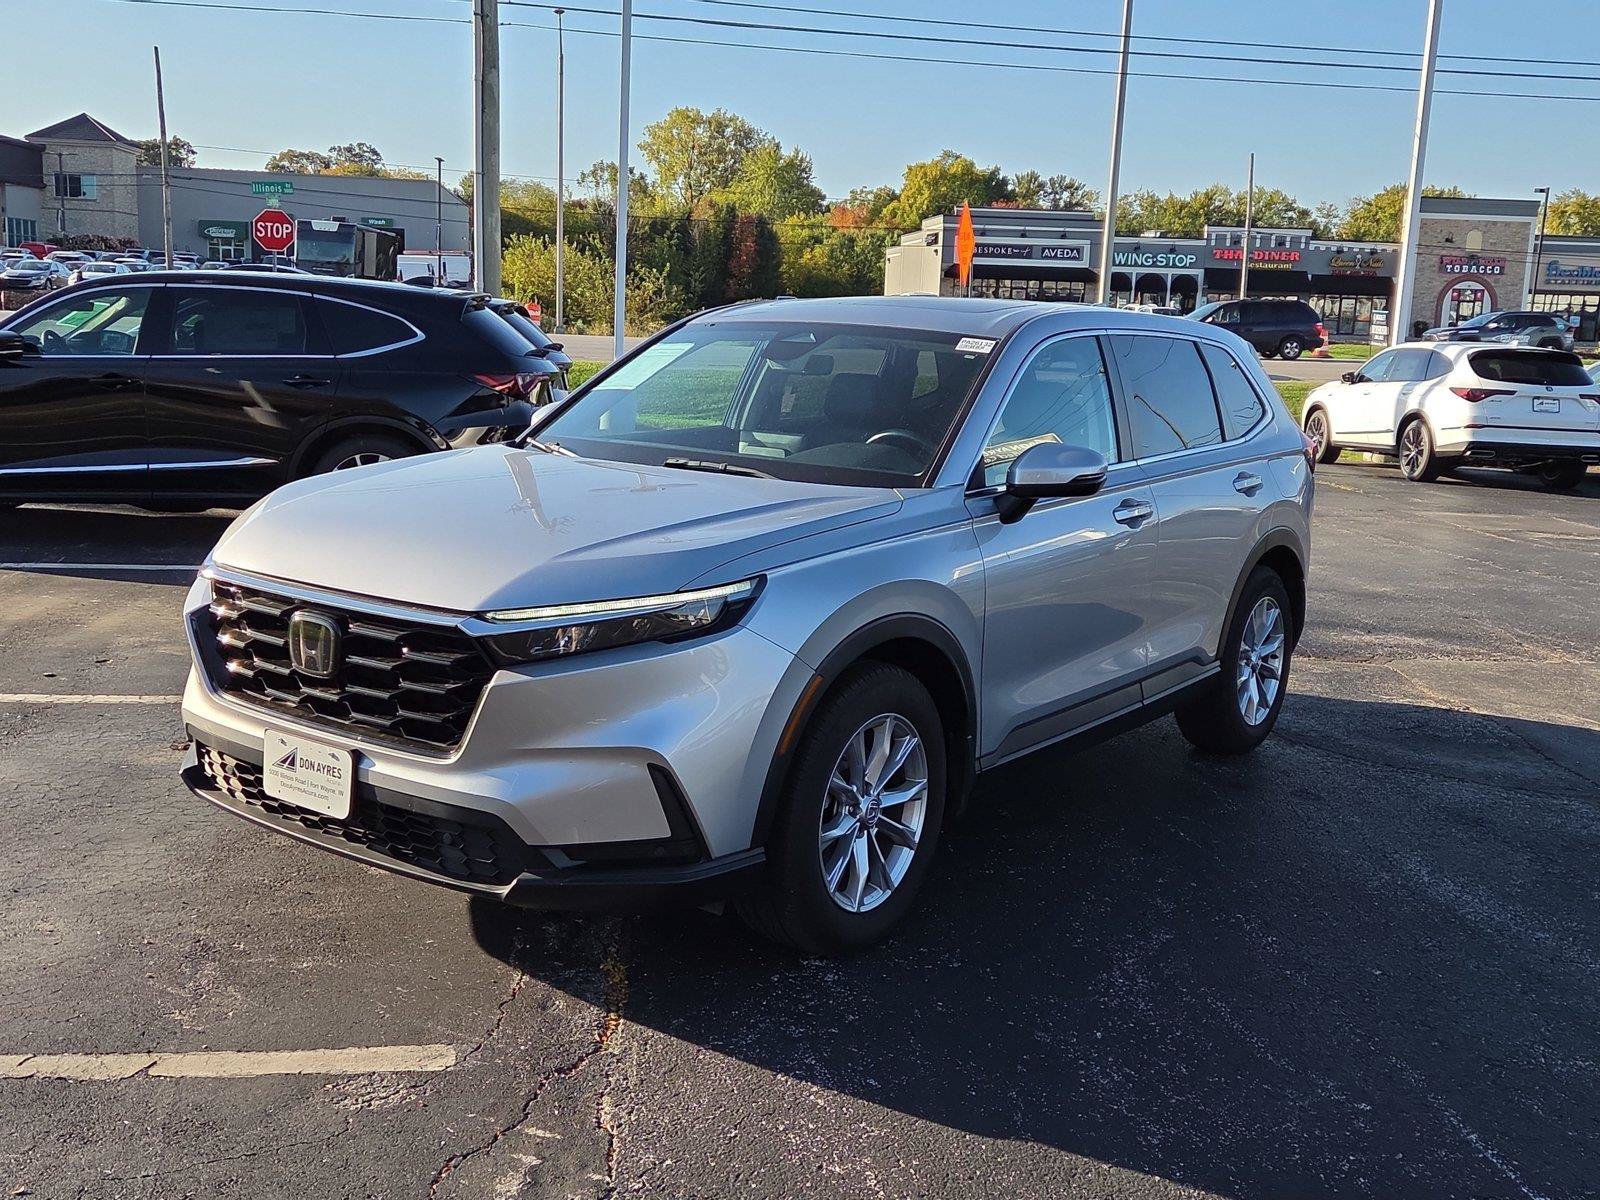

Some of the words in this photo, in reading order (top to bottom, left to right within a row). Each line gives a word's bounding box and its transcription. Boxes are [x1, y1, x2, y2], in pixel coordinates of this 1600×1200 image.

[253, 183, 282, 193] Illinois
[257, 221, 292, 239] STOP
[1042, 248, 1079, 258] AVEDA
[1213, 248, 1245, 259] THA
[1254, 251, 1300, 261] DINER
[1248, 262, 1293, 270] estaurant
[1446, 264, 1501, 274] TOBACCO
[299, 757, 315, 772] DON
[316, 762, 342, 780] AYRES
[294, 777, 307, 785] Road
